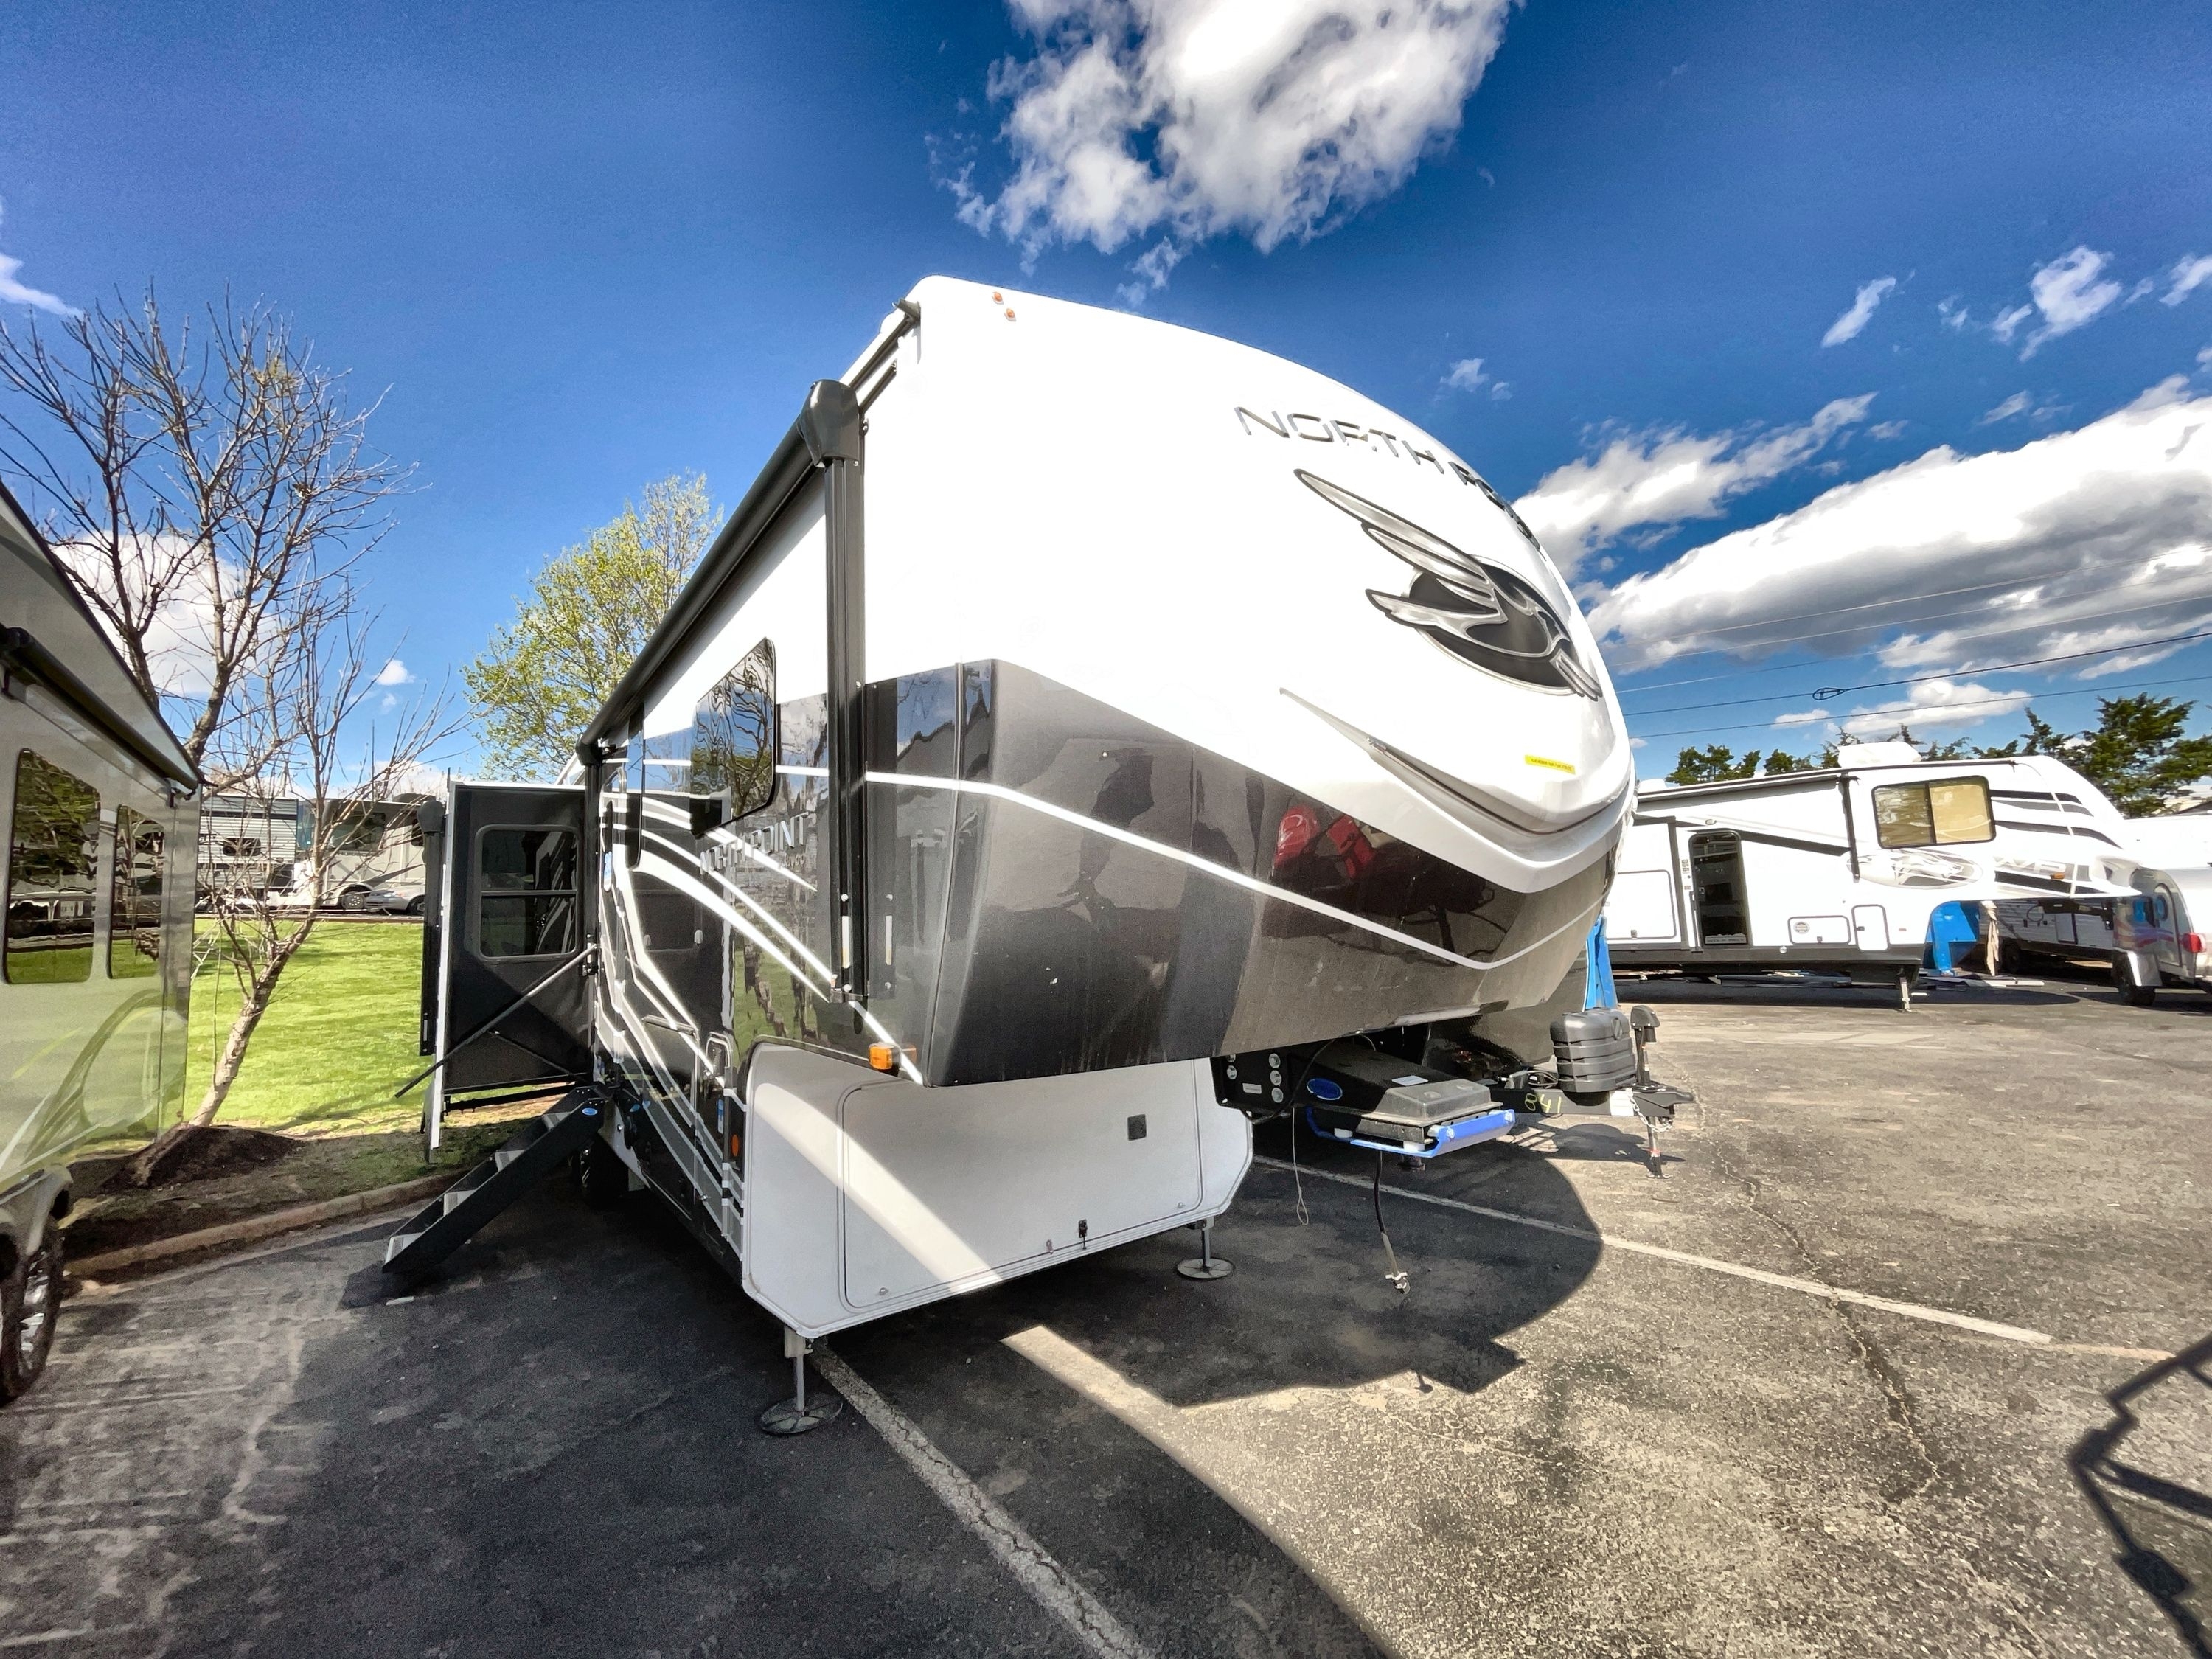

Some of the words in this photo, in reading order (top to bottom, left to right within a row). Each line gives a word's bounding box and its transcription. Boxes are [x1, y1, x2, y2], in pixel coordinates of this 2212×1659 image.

[1233, 406, 1444, 474] NORTH
[1448, 461, 1544, 556] POIN
[751, 811, 810, 857] POINT
[1524, 1093, 1562, 1113] 841
